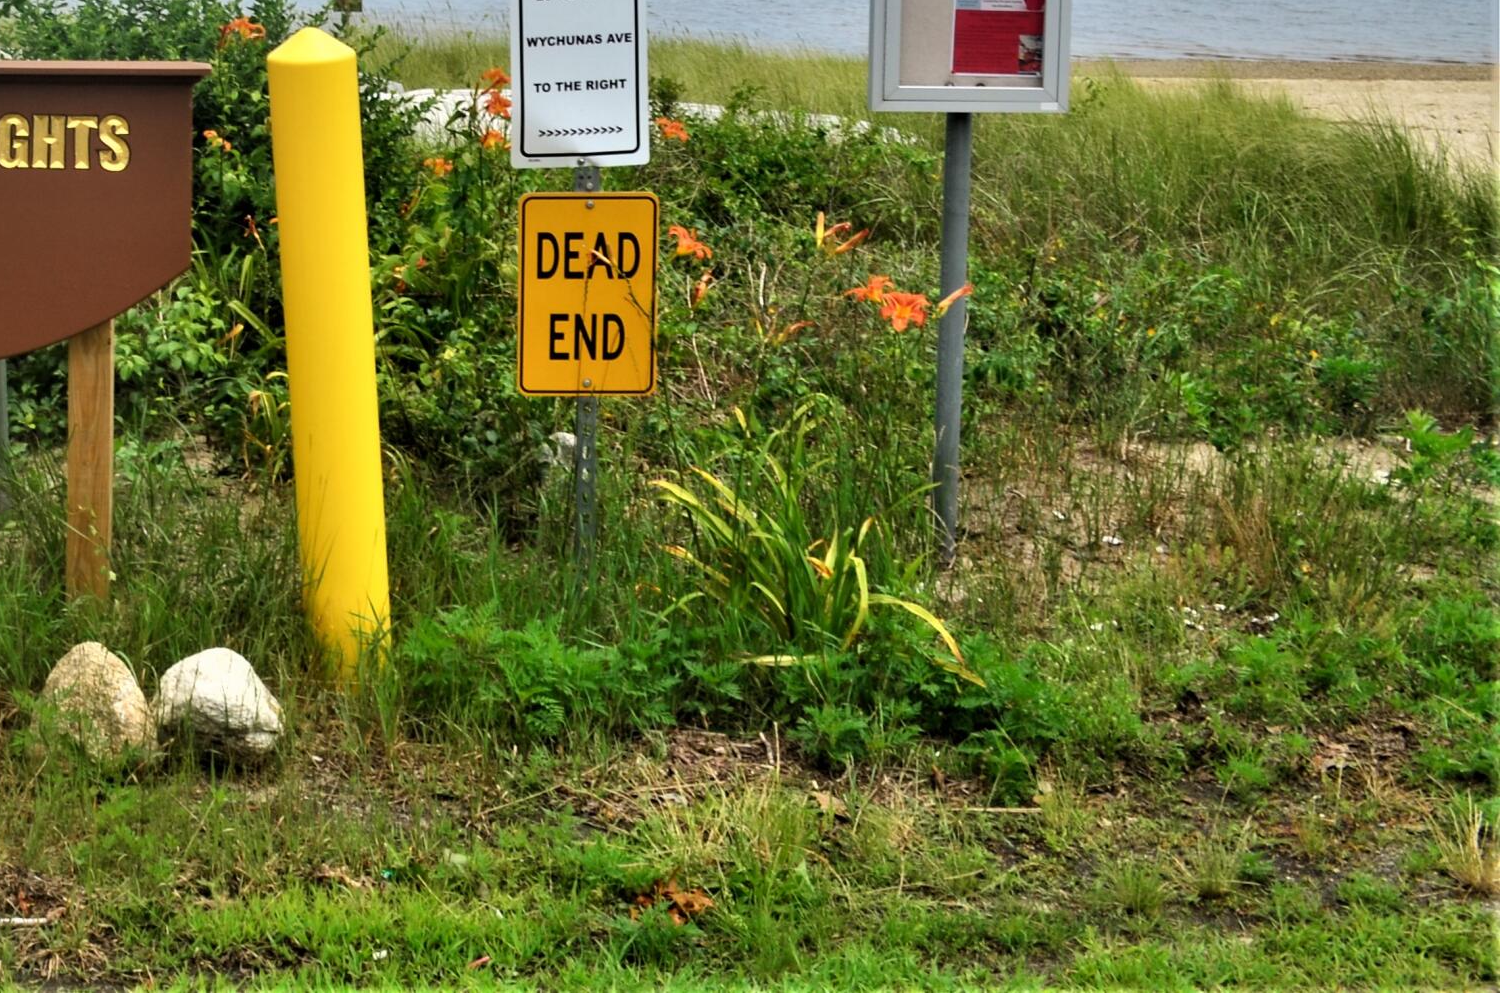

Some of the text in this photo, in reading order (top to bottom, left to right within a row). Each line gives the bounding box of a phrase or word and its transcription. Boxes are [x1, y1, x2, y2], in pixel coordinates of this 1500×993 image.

[527, 33, 631, 47] WYCHUNAS AVE
[534, 79, 626, 92] TO THE RIGHT
[537, 232, 641, 279] DEAD
[550, 314, 625, 360] END
